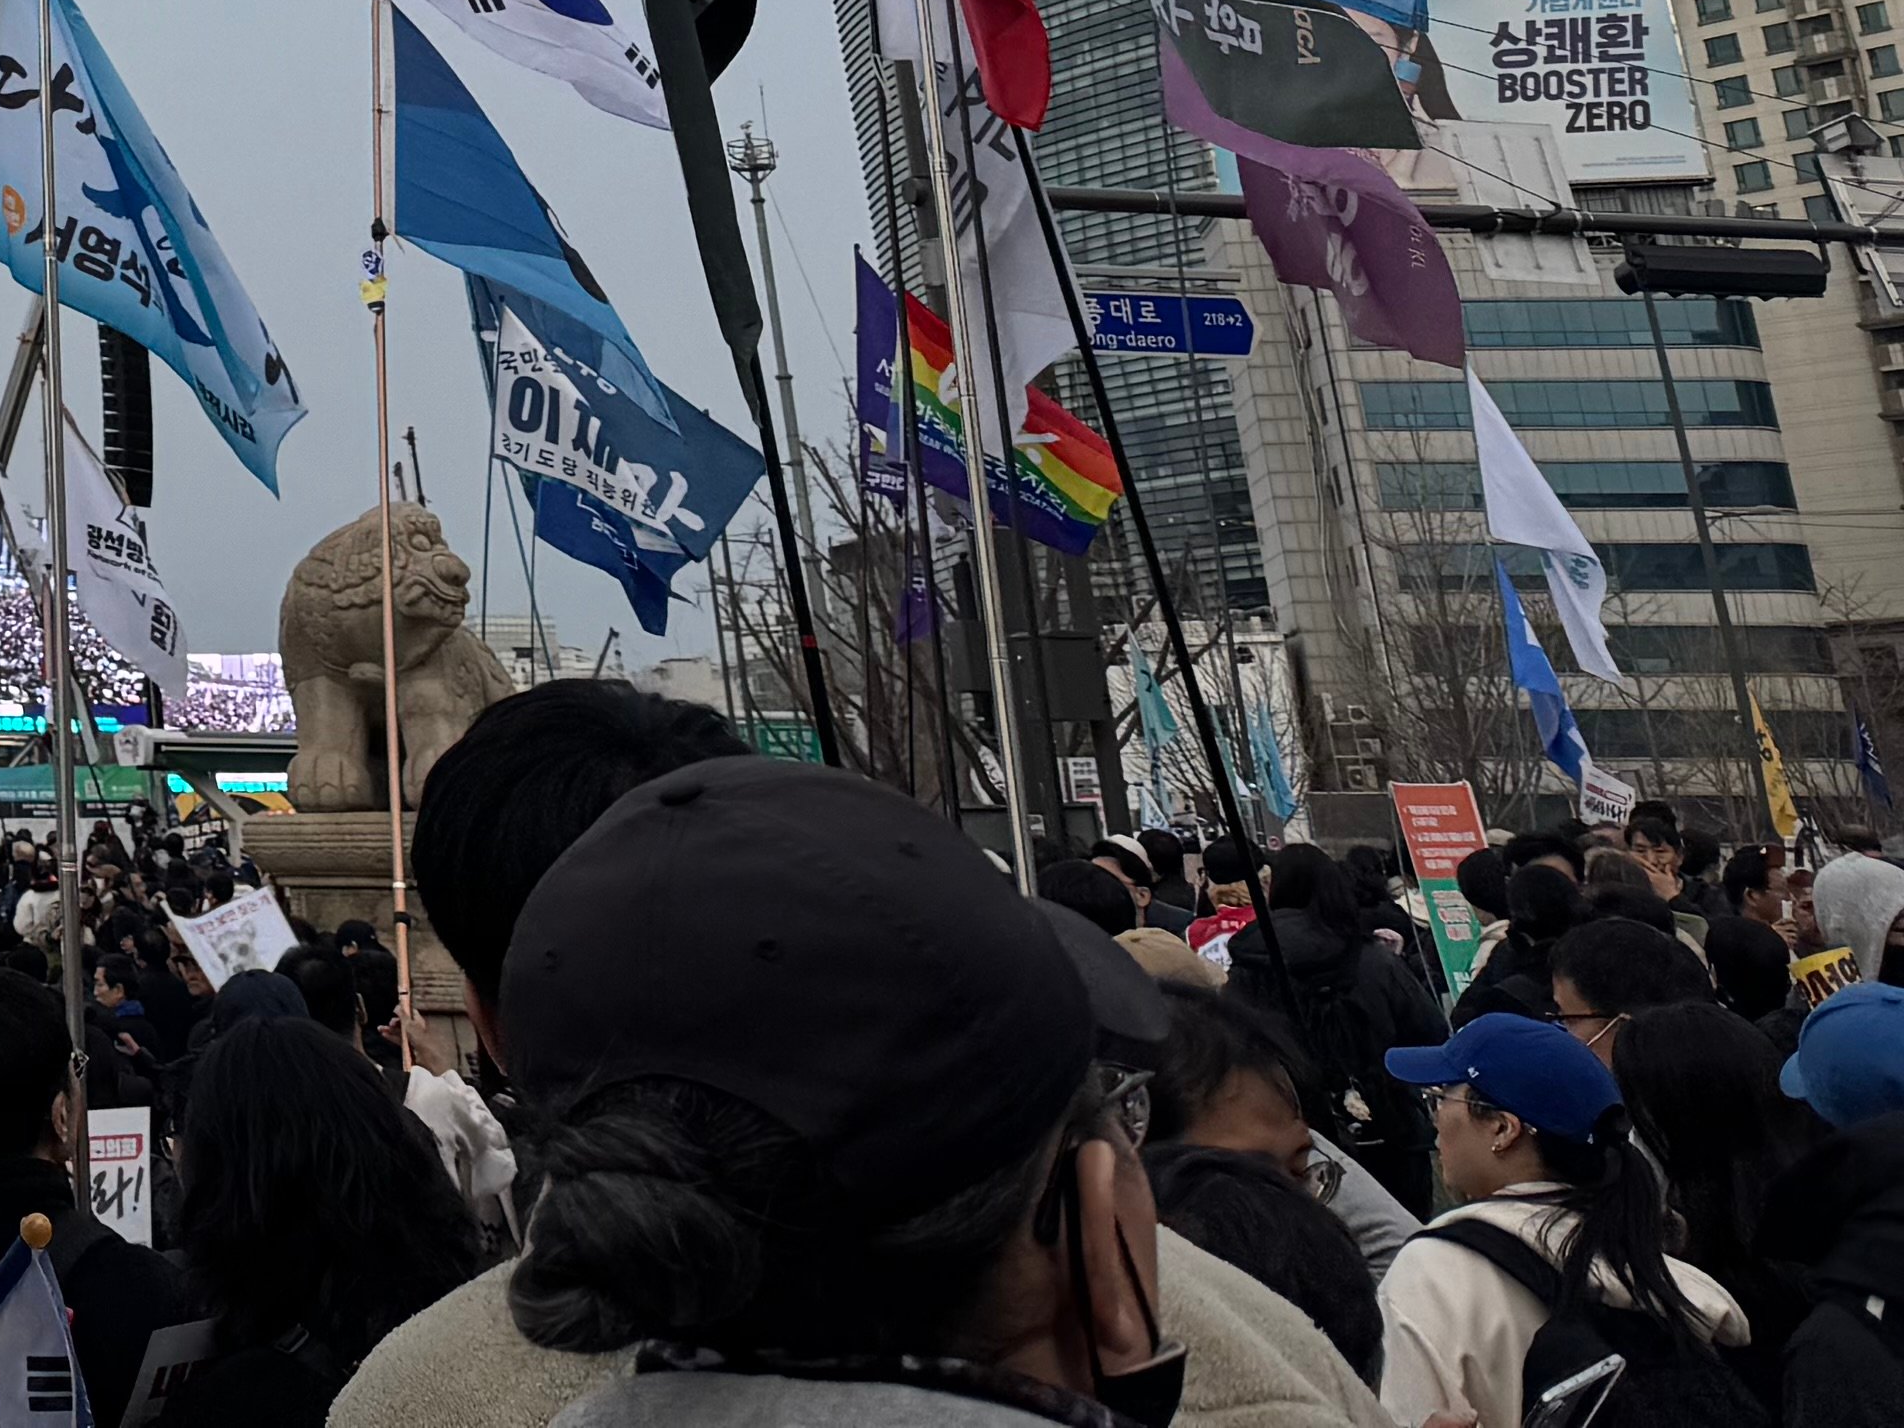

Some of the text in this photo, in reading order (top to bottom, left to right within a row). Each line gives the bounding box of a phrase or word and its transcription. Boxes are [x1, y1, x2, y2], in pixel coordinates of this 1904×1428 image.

[1489, 13, 1650, 69] 상쾌환
[1497, 66, 1649, 103] BOOSTER
[1565, 99, 1651, 133] ZERO
[1084, 298, 1162, 333] 종대로
[508, 376, 620, 475] 이재
